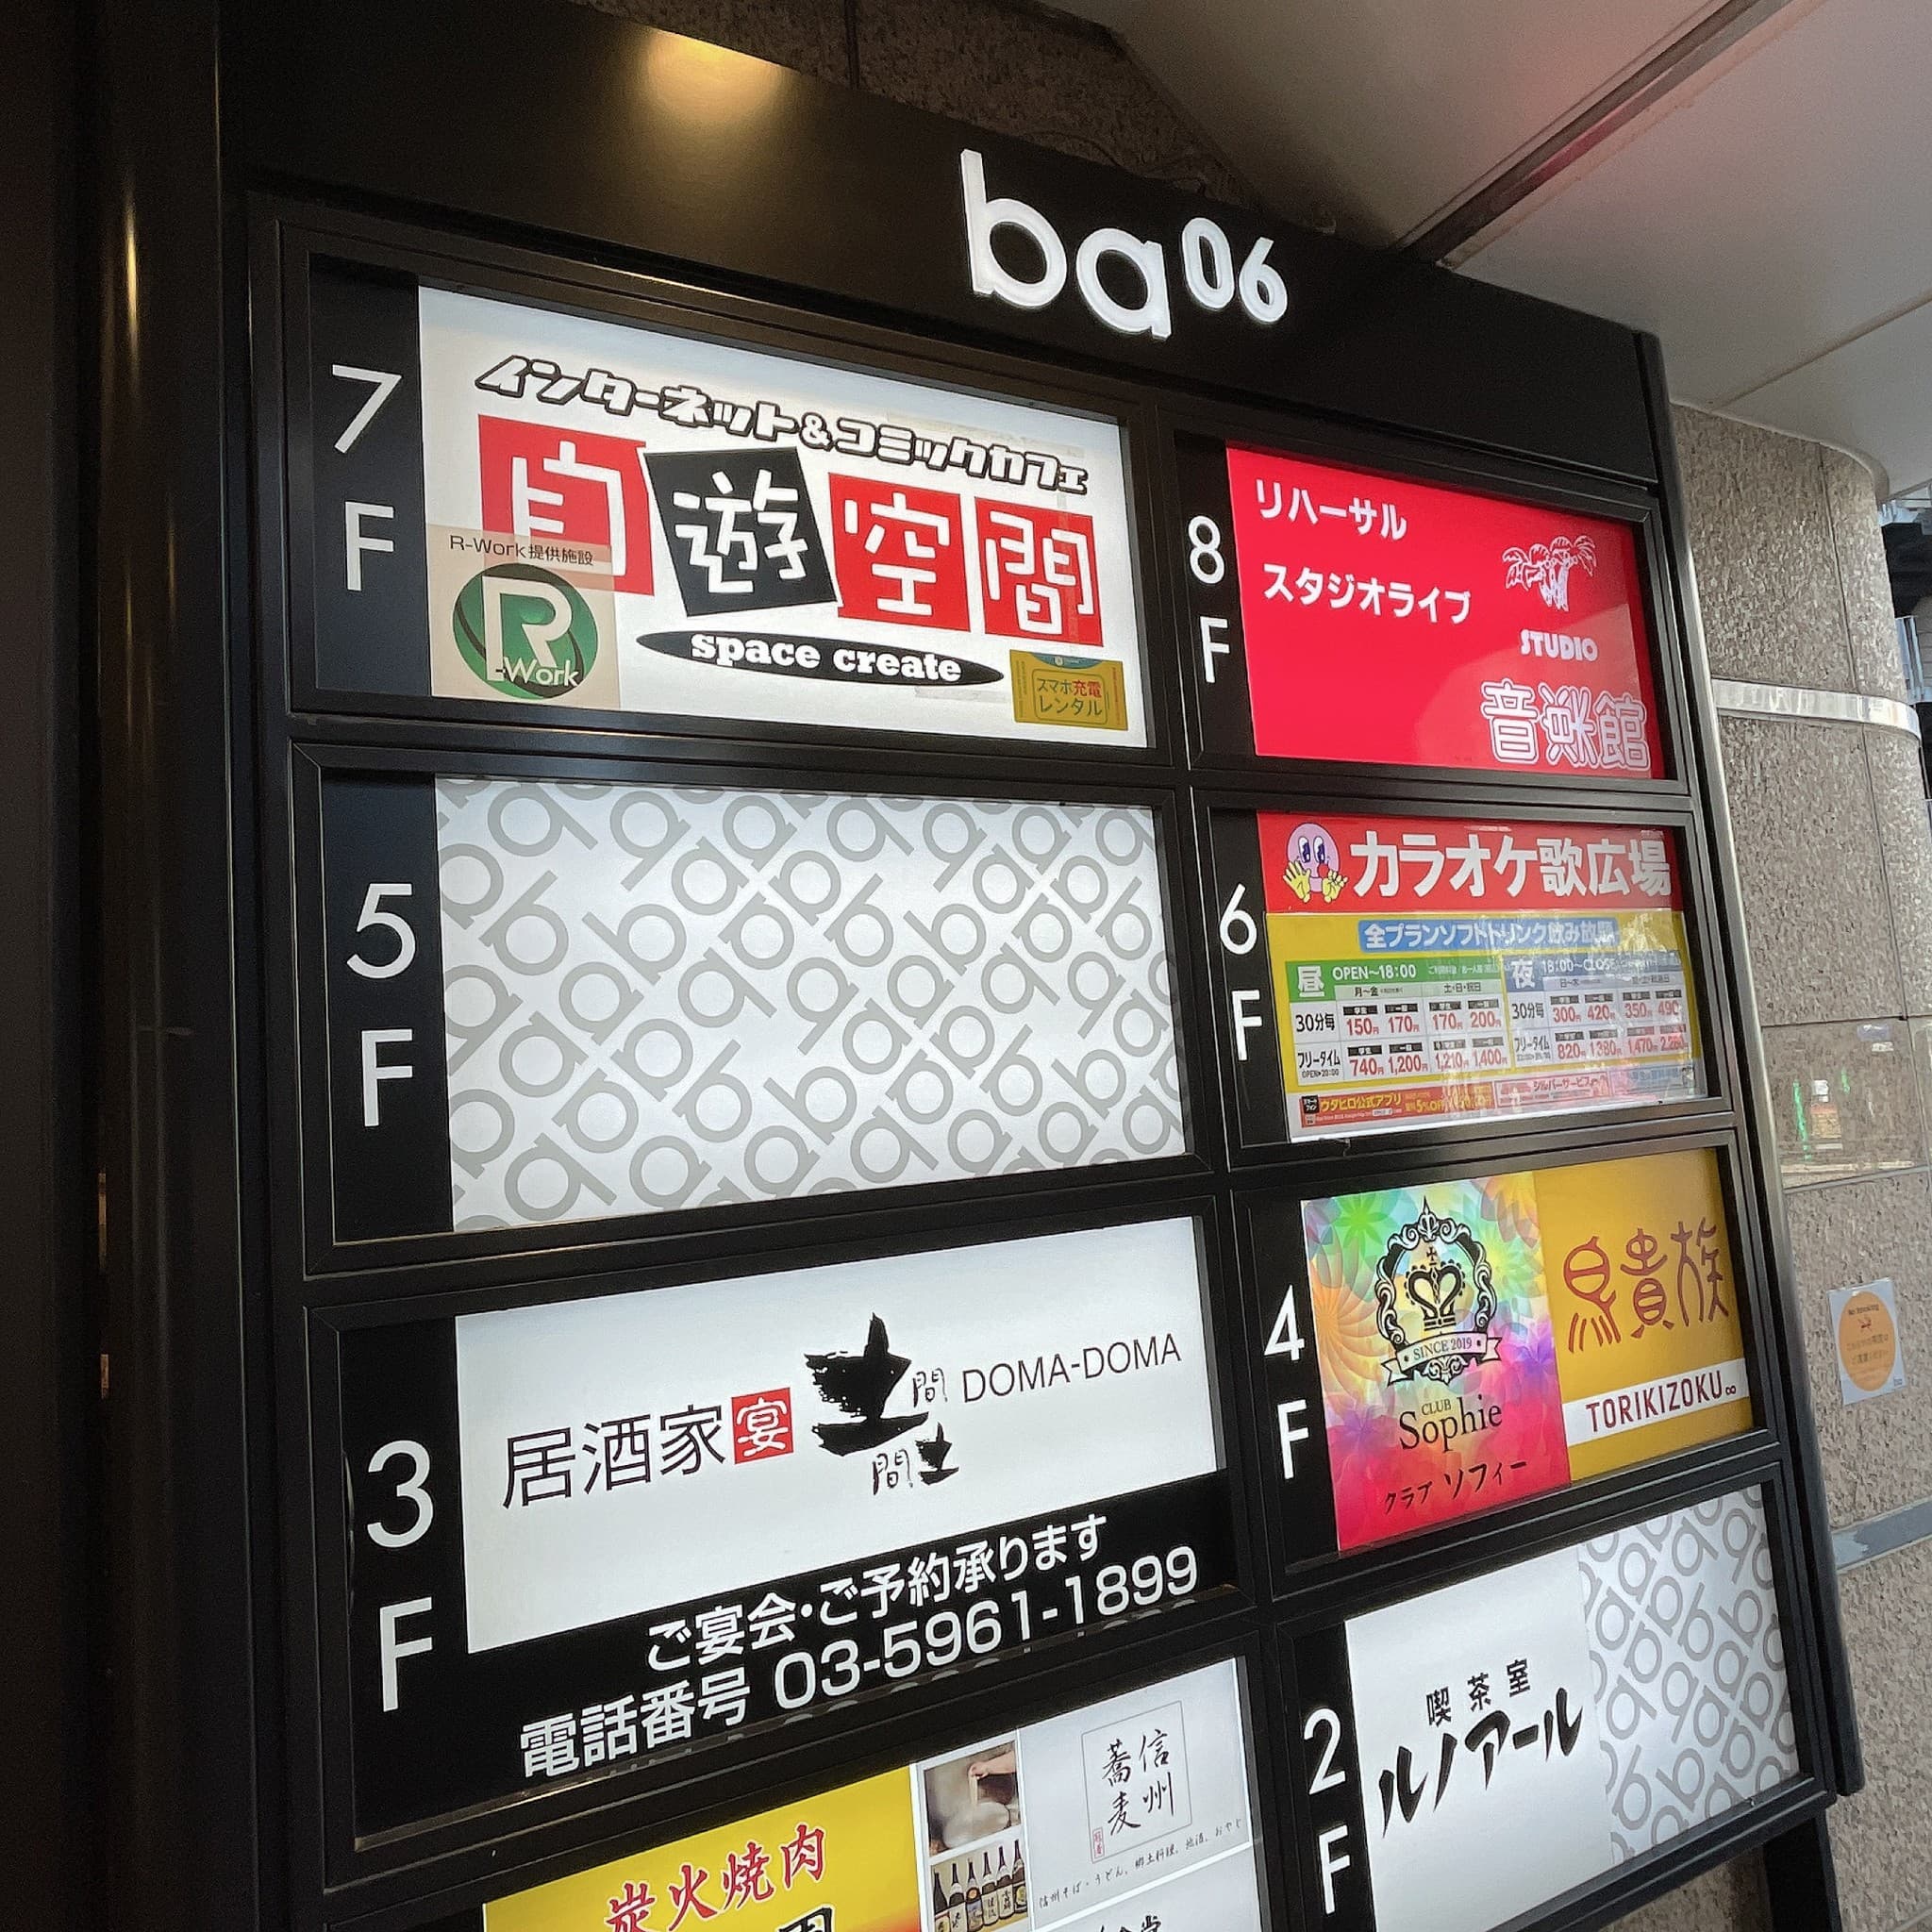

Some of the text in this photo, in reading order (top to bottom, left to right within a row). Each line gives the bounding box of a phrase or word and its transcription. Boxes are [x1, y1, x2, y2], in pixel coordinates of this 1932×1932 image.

[508, 434, 1098, 641] 自遊空間
[1256, 479, 1408, 541] リハーサル
[1262, 563, 1471, 624] スタジオライブ
[690, 632, 963, 683] space create
[1520, 629, 1599, 661] STUDIO
[1037, 677, 1102, 698] スマホ充電
[1040, 694, 1102, 716] レンタル
[1350, 830, 1673, 899] カラオケ歌広場
[1297, 965, 1325, 997] 昼
[1510, 958, 1536, 990] 夜
[1297, 1049, 1341, 1069] フリータイム
[961, 1331, 1183, 1405] DOMA-DOMA
[1412, 1335, 1474, 1361] SINCE 2019
[1399, 1393, 1503, 1456] Sophie
[1421, 1397, 1453, 1417] CLUB
[1384, 1459, 1527, 1515] クラブ ソフィー
[647, 1512, 1108, 1674] ご宴会・ご予約承ります
[520, 1544, 1199, 1779] 電話番号 03-5961-1899
[1425, 1657, 1530, 1726] 喫茶室
[1378, 1687, 1584, 1839] ルノアール
